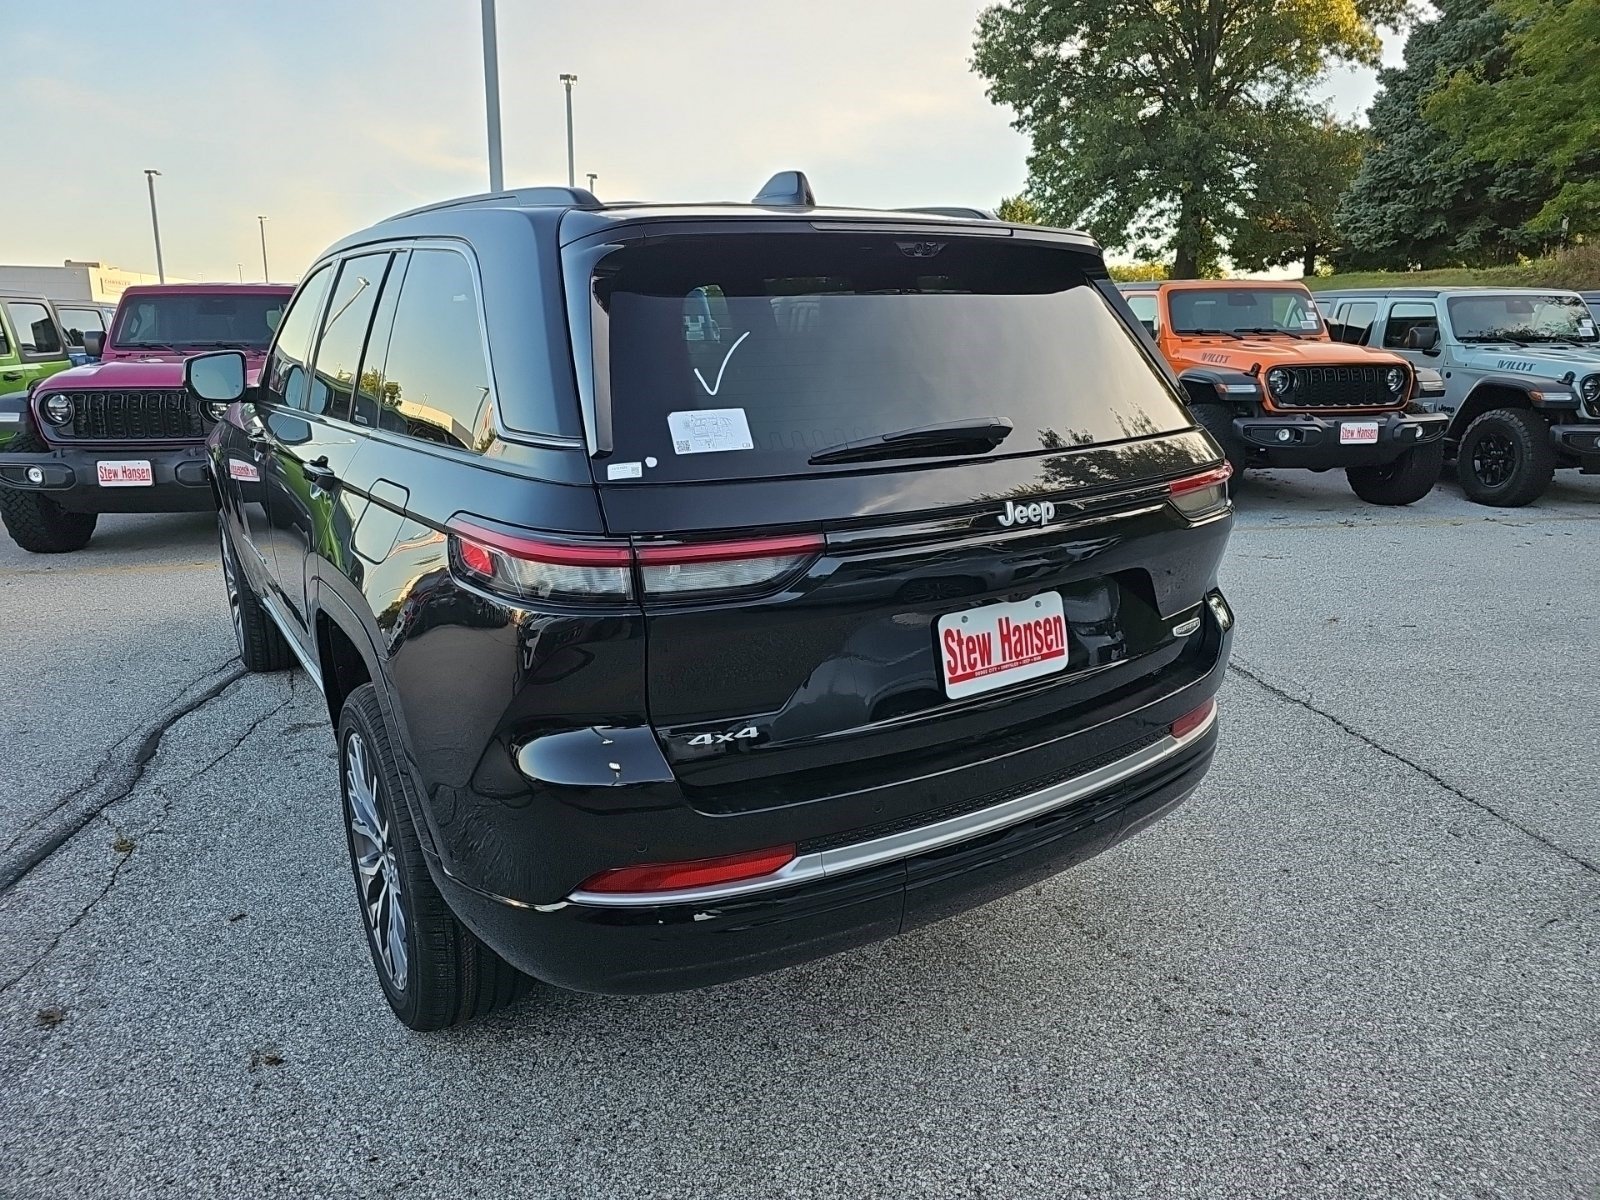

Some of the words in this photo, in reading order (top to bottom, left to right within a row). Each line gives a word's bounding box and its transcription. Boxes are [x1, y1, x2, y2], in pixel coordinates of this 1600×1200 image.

[1201, 352, 1231, 364] WILLYS
[1497, 359, 1536, 372] WILLYS
[1438, 404, 1455, 413] Jeep
[1342, 427, 1356, 438] Stew
[1357, 427, 1377, 438] Hansen
[99, 465, 119, 479] Stew
[121, 465, 151, 479] Hansen
[997, 501, 1055, 527] Jeep
[943, 628, 992, 676] Stew
[998, 615, 1065, 662] Hansen
[687, 726, 760, 746] 4x4
